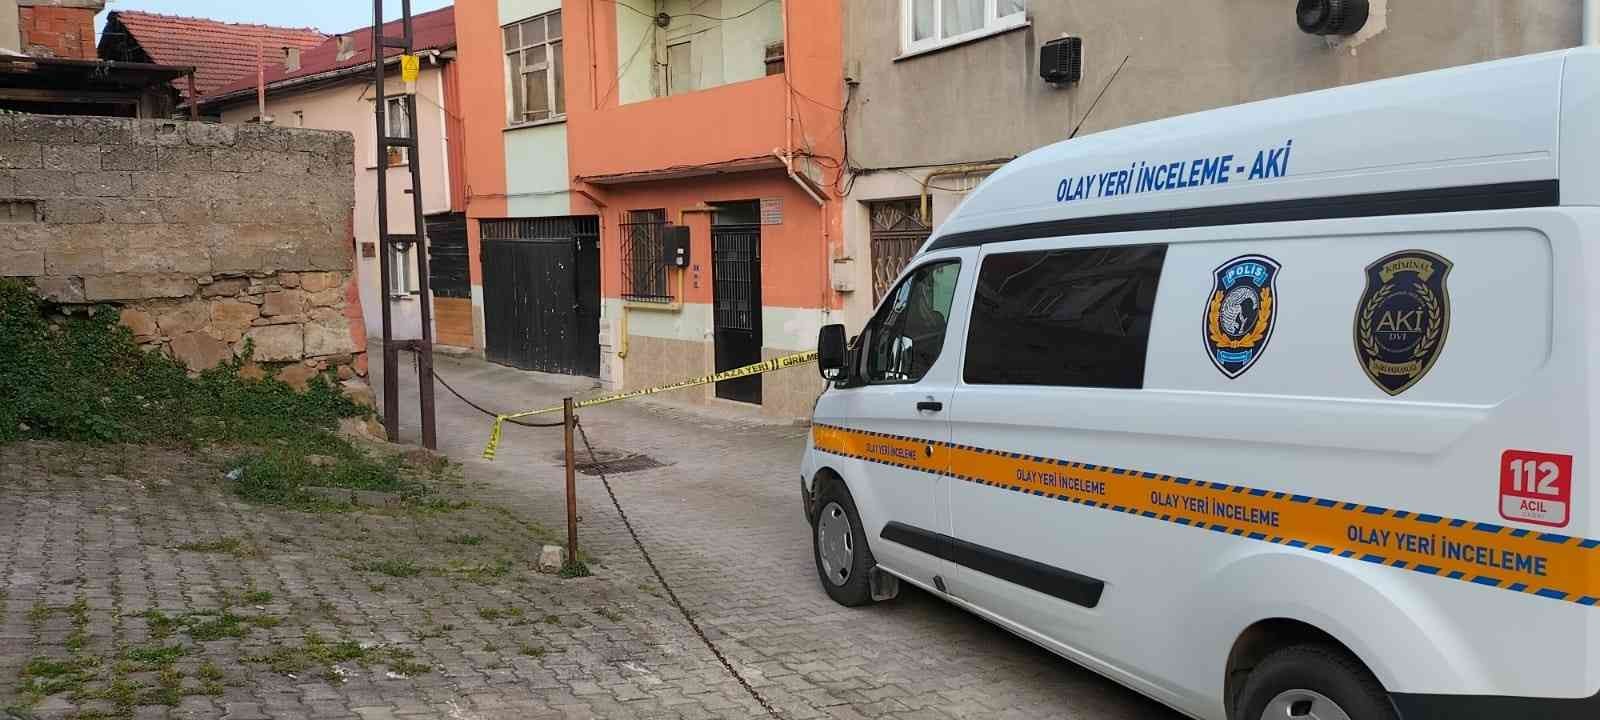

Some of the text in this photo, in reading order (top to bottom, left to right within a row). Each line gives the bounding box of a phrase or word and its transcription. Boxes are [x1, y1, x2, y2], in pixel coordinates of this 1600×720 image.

[1056, 174, 1096, 202] OLAY
[1098, 162, 1136, 197] YERİ
[1135, 154, 1234, 194] İNCELEME
[1248, 139, 1293, 180] AKİ
[1376, 306, 1424, 331] AKİ
[717, 367, 745, 380] KAZA
[1016, 468, 1105, 495] OLAY YERİ İNCELEME
[1510, 458, 1560, 496] 112
[1150, 490, 1280, 527] OLAY YERİ İNCELEME
[1347, 524, 1548, 577] OLAY YERİ İNCELEME
